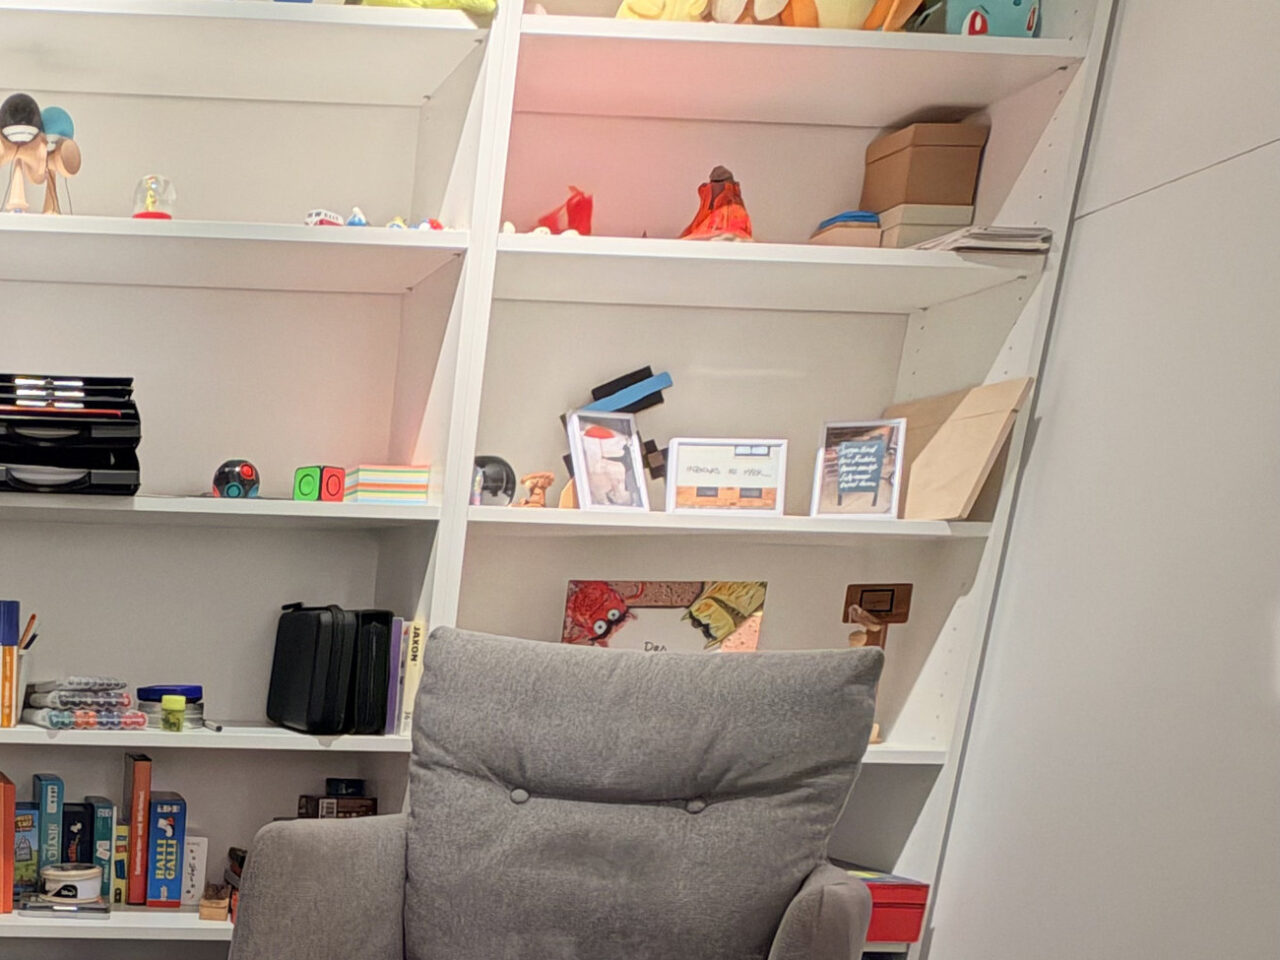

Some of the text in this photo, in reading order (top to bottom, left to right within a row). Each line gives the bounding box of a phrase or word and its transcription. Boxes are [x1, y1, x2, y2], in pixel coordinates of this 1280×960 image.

[411, 626, 421, 661] JAXON
[155, 839, 166, 879] HALLI
[166, 839, 176, 879] GALLI
